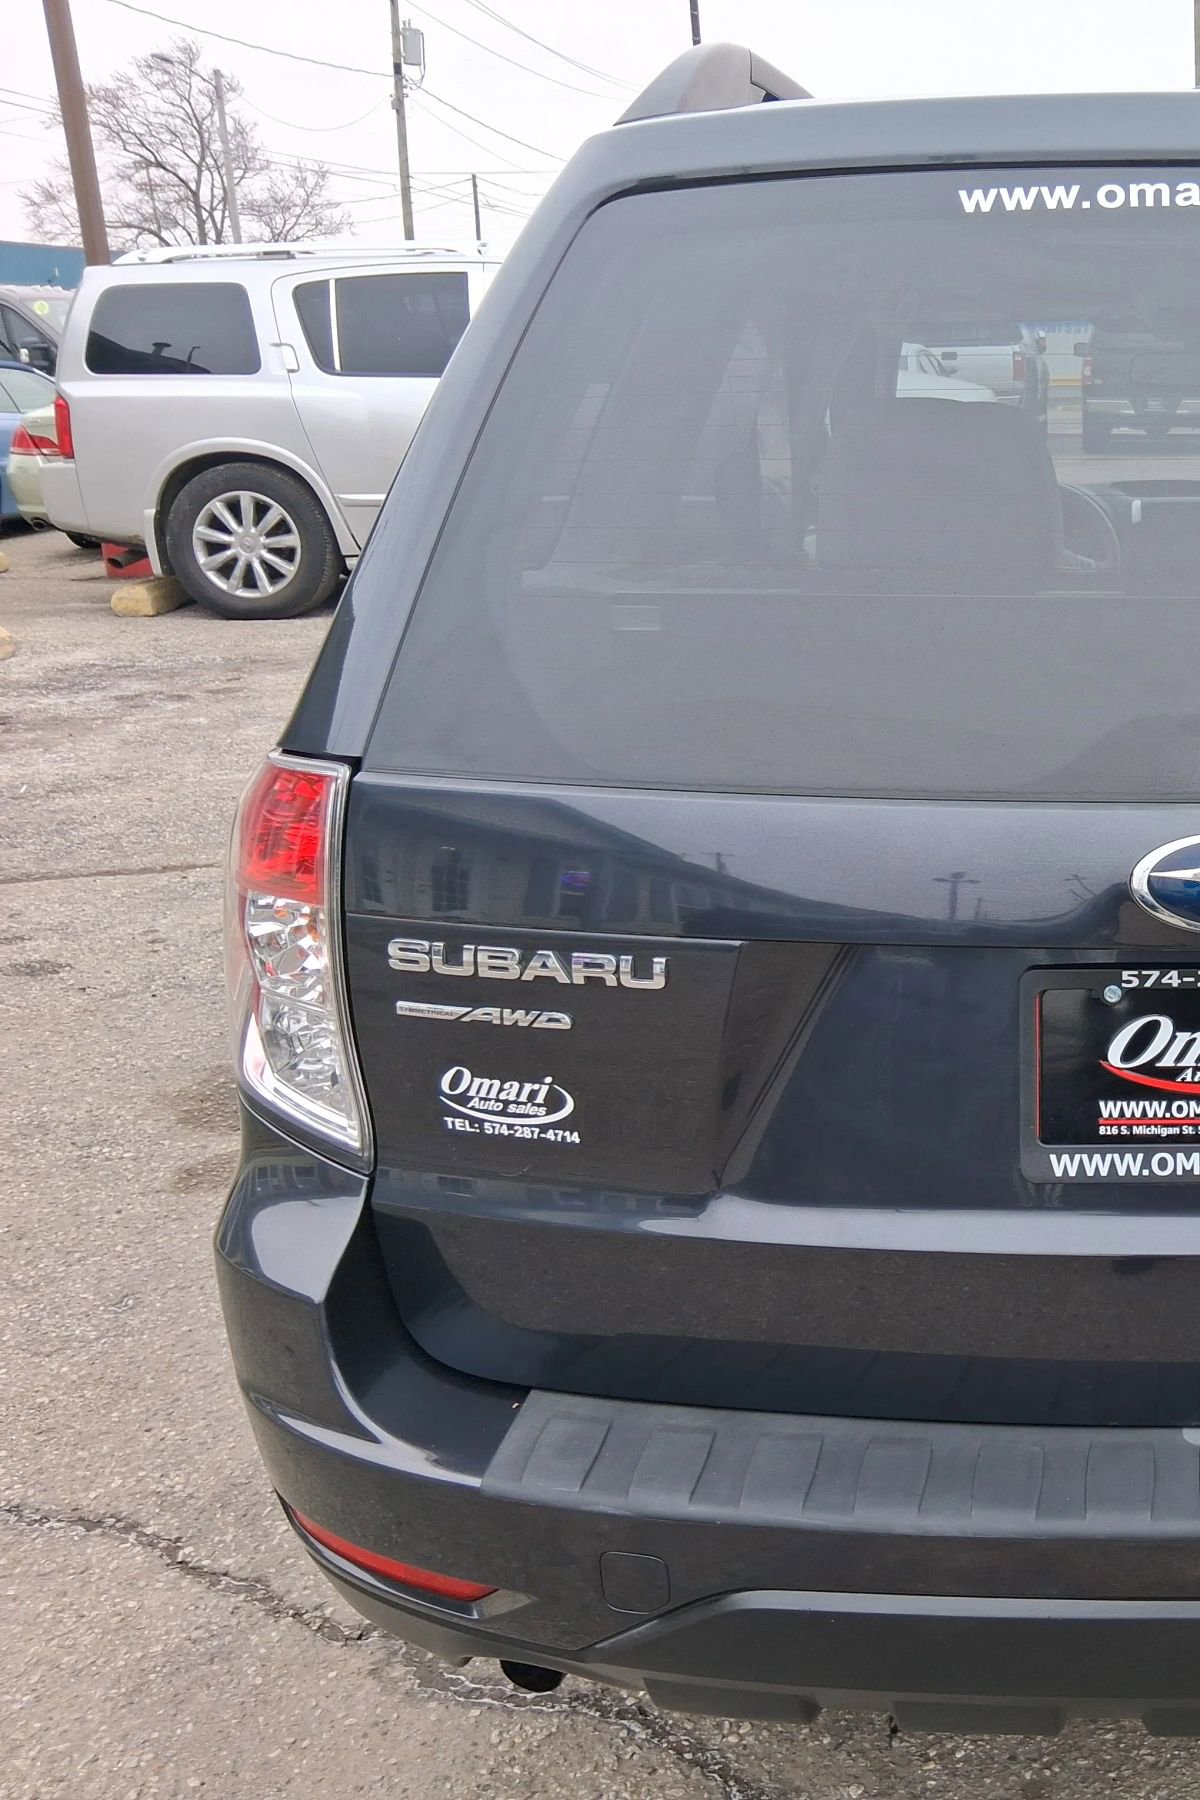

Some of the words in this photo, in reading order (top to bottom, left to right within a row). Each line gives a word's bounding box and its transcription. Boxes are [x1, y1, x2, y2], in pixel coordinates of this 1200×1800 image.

[388, 938, 669, 990] SUBARU
[458, 1006, 573, 1030] AWD
[440, 1066, 553, 1104] Omari
[467, 1097, 503, 1112] Auto
[507, 1102, 548, 1116] sales
[443, 1117, 480, 1133] TEL:
[484, 1122, 581, 1144] 574-287-4714
[1099, 1125, 1119, 1135] 816
[1120, 1125, 1131, 1135] S.
[1132, 1125, 1180, 1137] Michigan
[1181, 1125, 1196, 1135] St.
